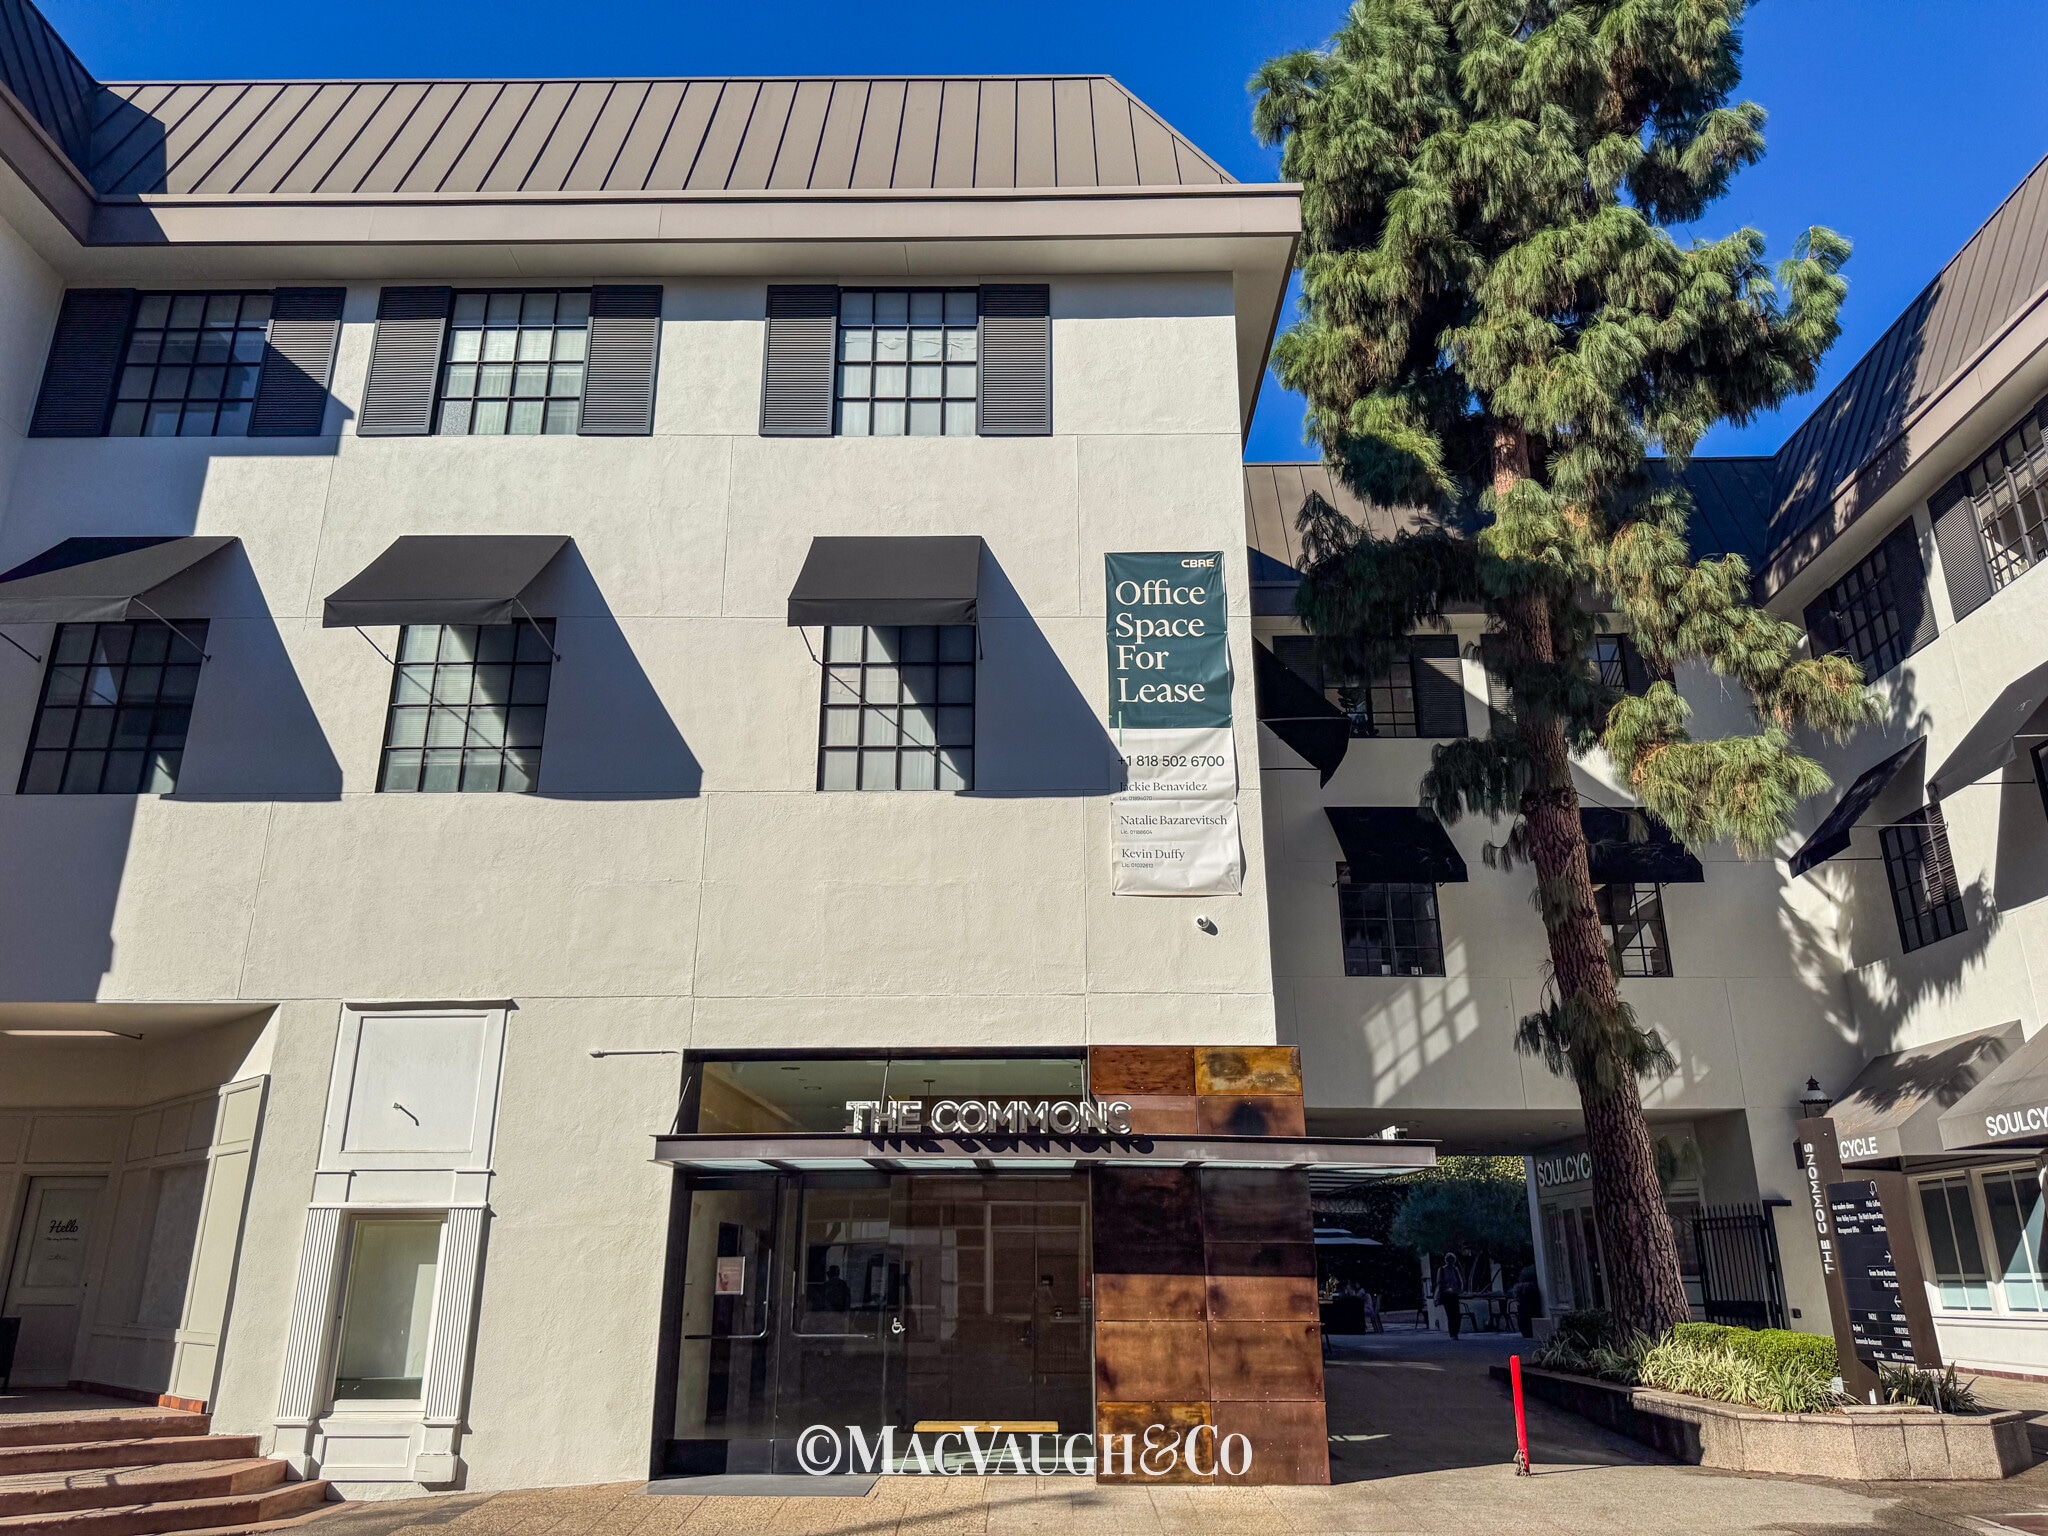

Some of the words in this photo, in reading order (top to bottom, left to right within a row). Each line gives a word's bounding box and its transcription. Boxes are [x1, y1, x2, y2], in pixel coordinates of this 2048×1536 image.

[1181, 559, 1215, 568] CBRE
[1115, 579, 1206, 606] Office
[1115, 612, 1205, 645] Space
[1116, 645, 1169, 670] For
[1117, 677, 1206, 703] Lease
[1118, 755, 1132, 767] +1
[1136, 755, 1159, 767] 818
[1162, 755, 1188, 767] 502
[1191, 755, 1225, 767] 6700
[1119, 781, 1151, 793] Jackie
[1153, 781, 1208, 792] Benavidez
[1120, 815, 1158, 825] Natalie
[1160, 815, 1228, 825] Bazarevitsch
[1122, 848, 1152, 859] Kevin
[1155, 849, 1186, 862] Duffy
[846, 1100, 922, 1134] THE
[931, 1100, 1133, 1135] COMMONS
[1985, 1106, 2048, 1137] SOULCY
[1839, 1136, 1879, 1158] CYCLE
[1803, 1142, 1828, 1234] COMMONS
[49, 1218, 79, 1233] Hello
[1820, 1239, 1836, 1275] THE
